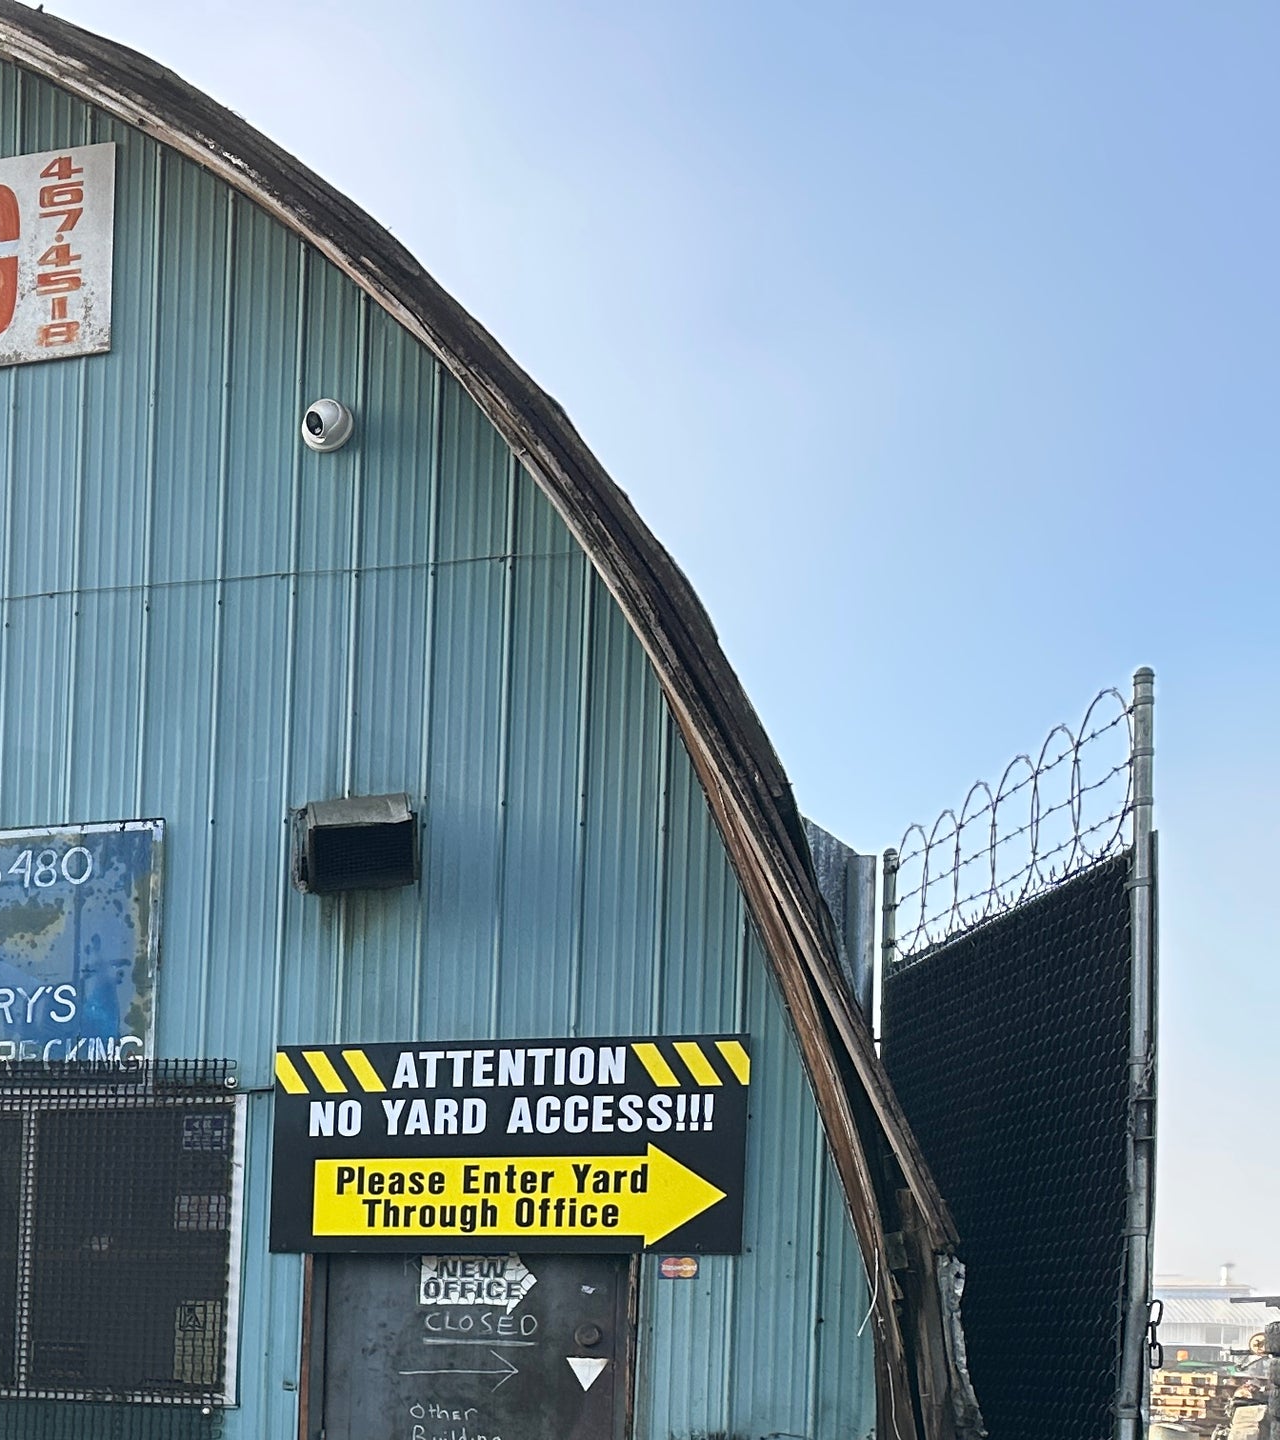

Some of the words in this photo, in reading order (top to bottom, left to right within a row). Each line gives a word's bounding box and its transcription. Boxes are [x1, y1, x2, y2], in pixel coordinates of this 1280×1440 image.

[391, 1046, 628, 1090] ATTENTION
[308, 1099, 362, 1138] NO
[382, 1097, 487, 1136] YARD
[506, 1093, 716, 1136] ACCESS!!!
[336, 1165, 446, 1196] Please
[462, 1164, 555, 1195] Enter
[570, 1163, 649, 1194] Yard
[361, 1198, 499, 1233] Through
[514, 1197, 620, 1228] Office
[438, 1258, 507, 1279] NEW
[423, 1278, 521, 1300] OFFICE
[425, 1311, 538, 1335] CLOSED
